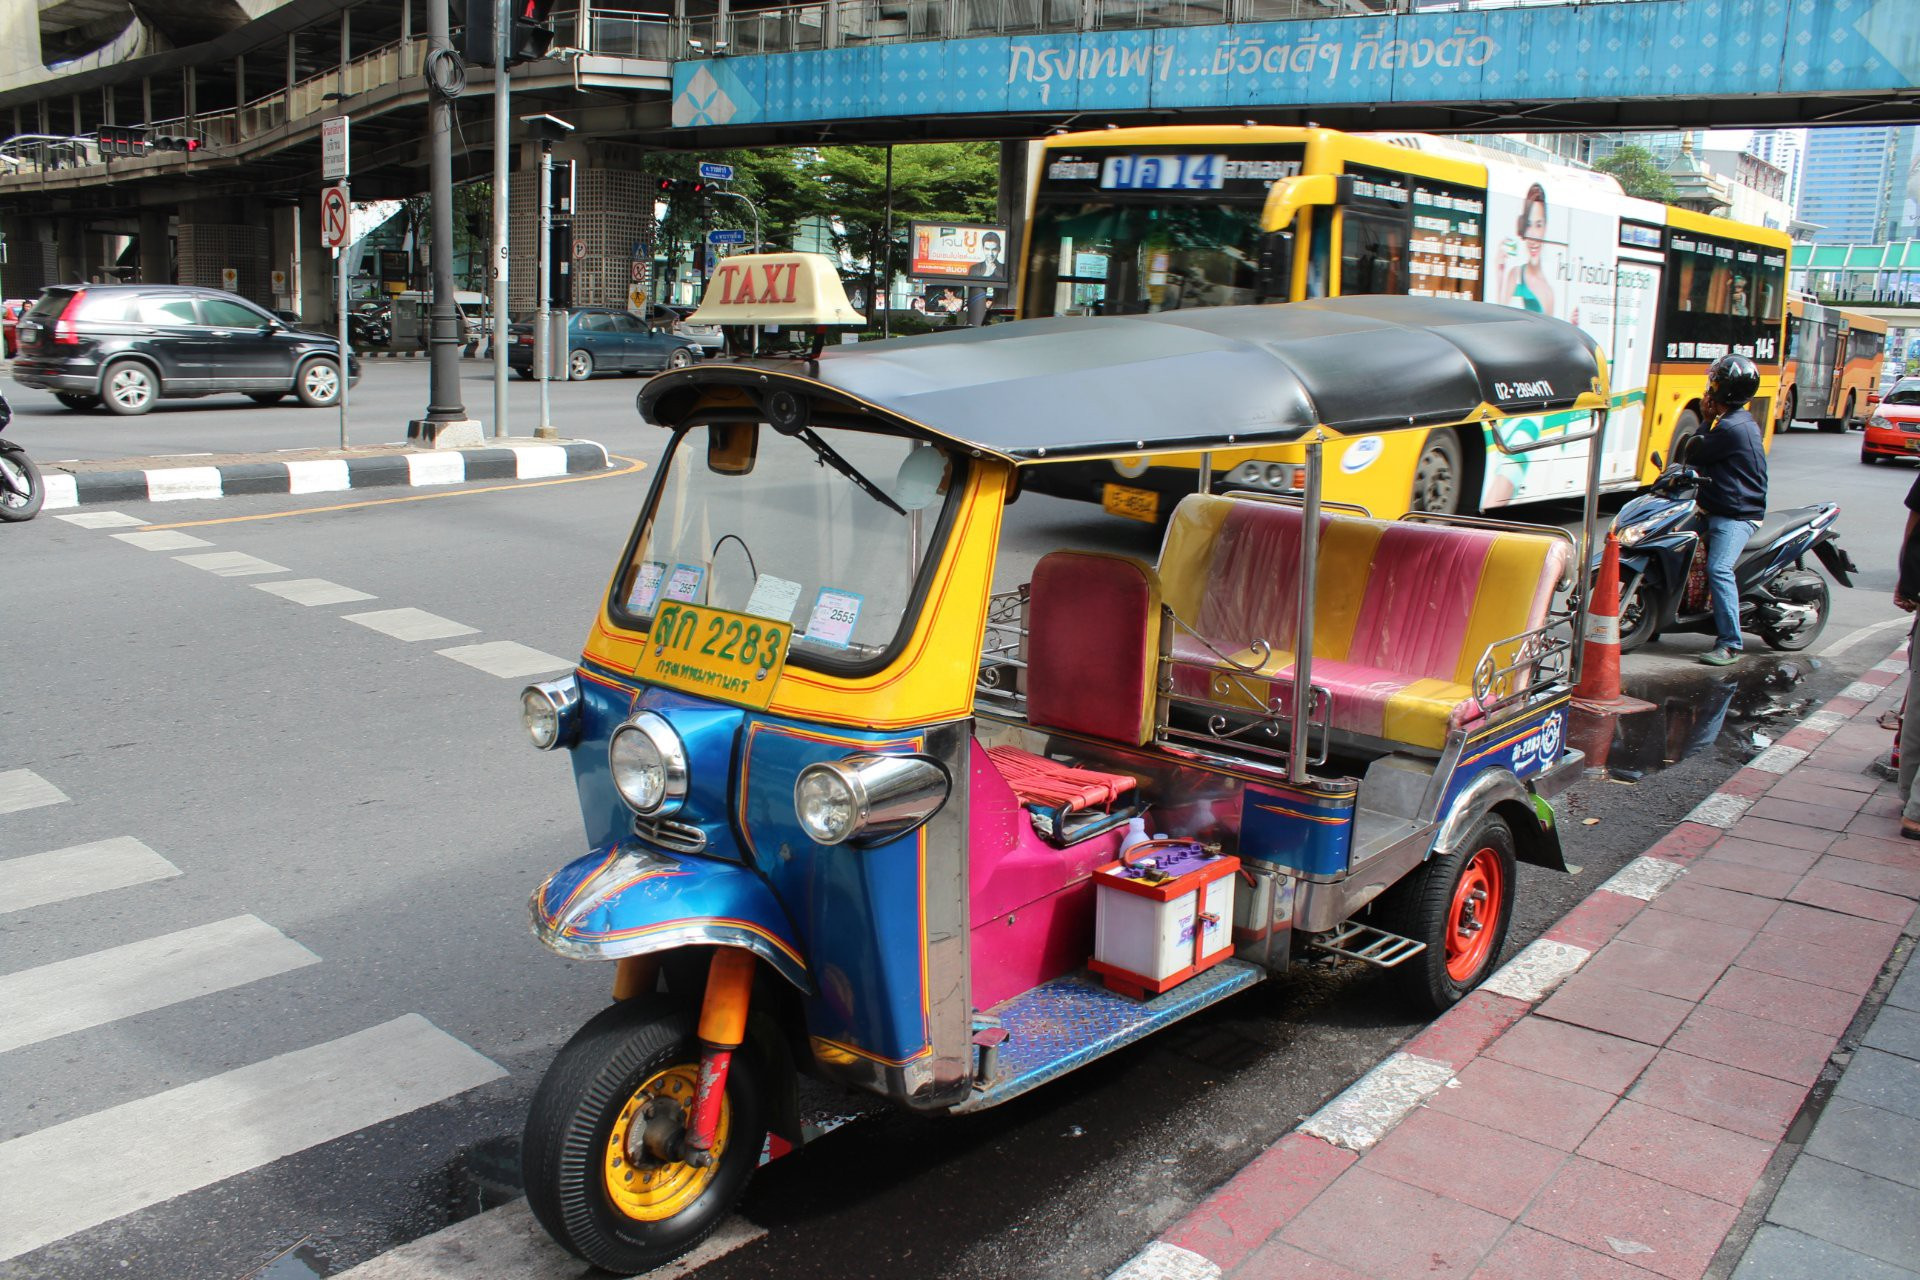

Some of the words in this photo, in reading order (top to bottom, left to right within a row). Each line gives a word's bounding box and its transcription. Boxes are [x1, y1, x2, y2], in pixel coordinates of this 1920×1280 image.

[1350, 22, 1495, 70] ที่ลงตัว
[1171, 154, 1215, 189] 14
[501, 246, 508, 258] 9
[718, 262, 800, 304] TAXI
[678, 582, 697, 594] 2557
[830, 609, 856, 624] 2555
[701, 616, 782, 670] 2283
[656, 659, 751, 694] กรุงเทพมหานคร
